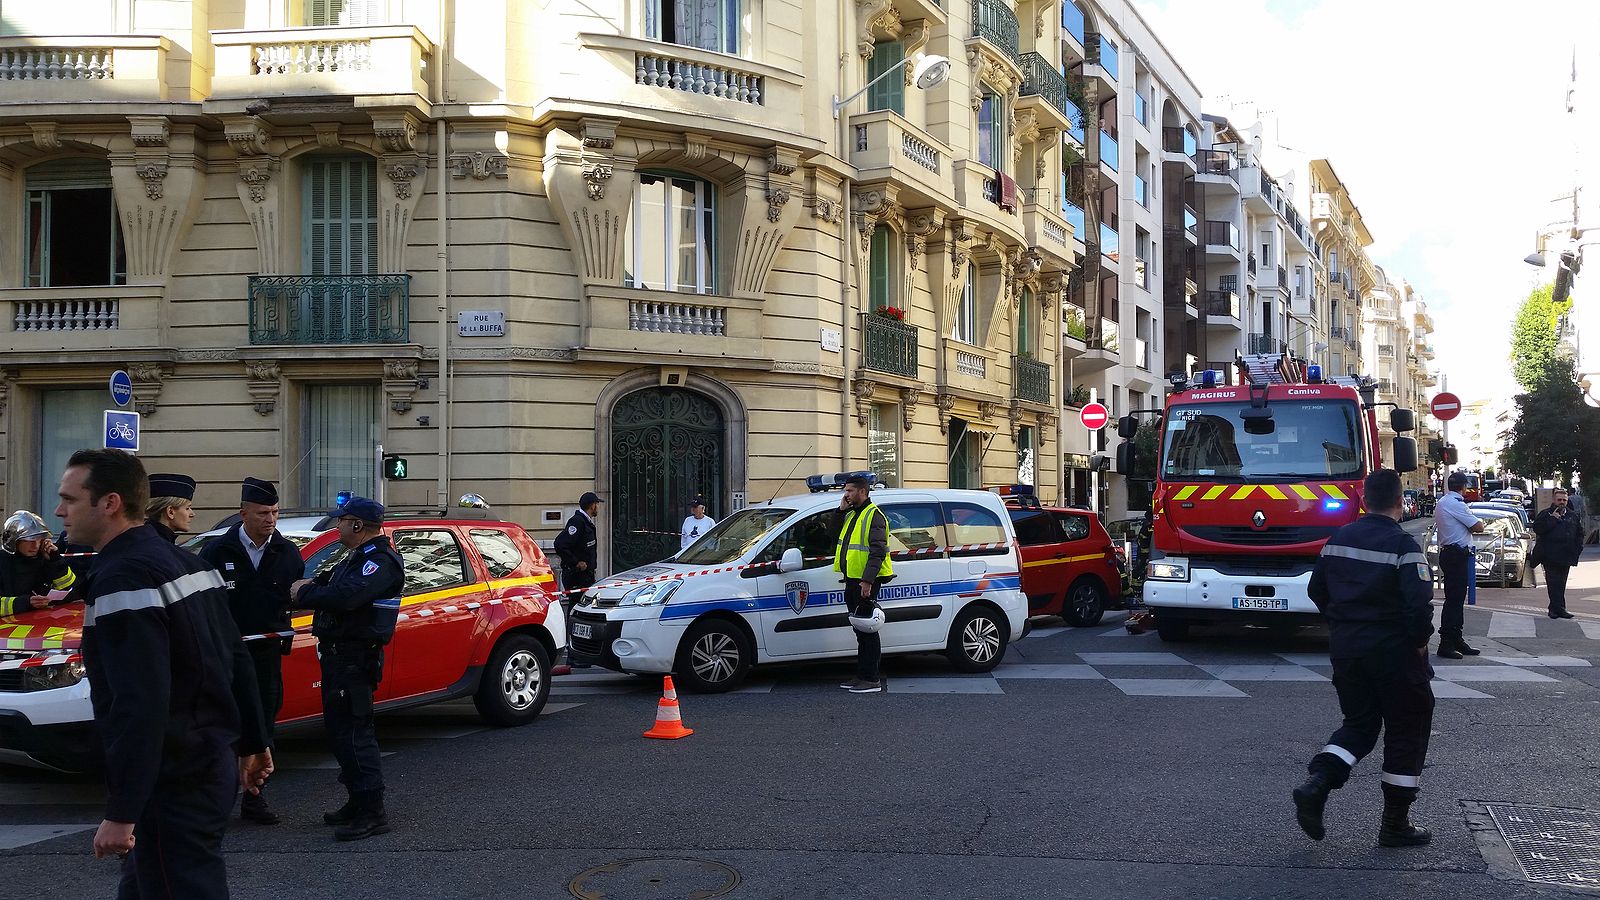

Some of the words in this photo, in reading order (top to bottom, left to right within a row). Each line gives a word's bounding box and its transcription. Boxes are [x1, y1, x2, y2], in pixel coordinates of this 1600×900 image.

[1192, 392, 1236, 400] MAGIRUS
[878, 586, 928, 600] UNICIPALE
[1240, 600, 1280, 608] AS-159-TP
